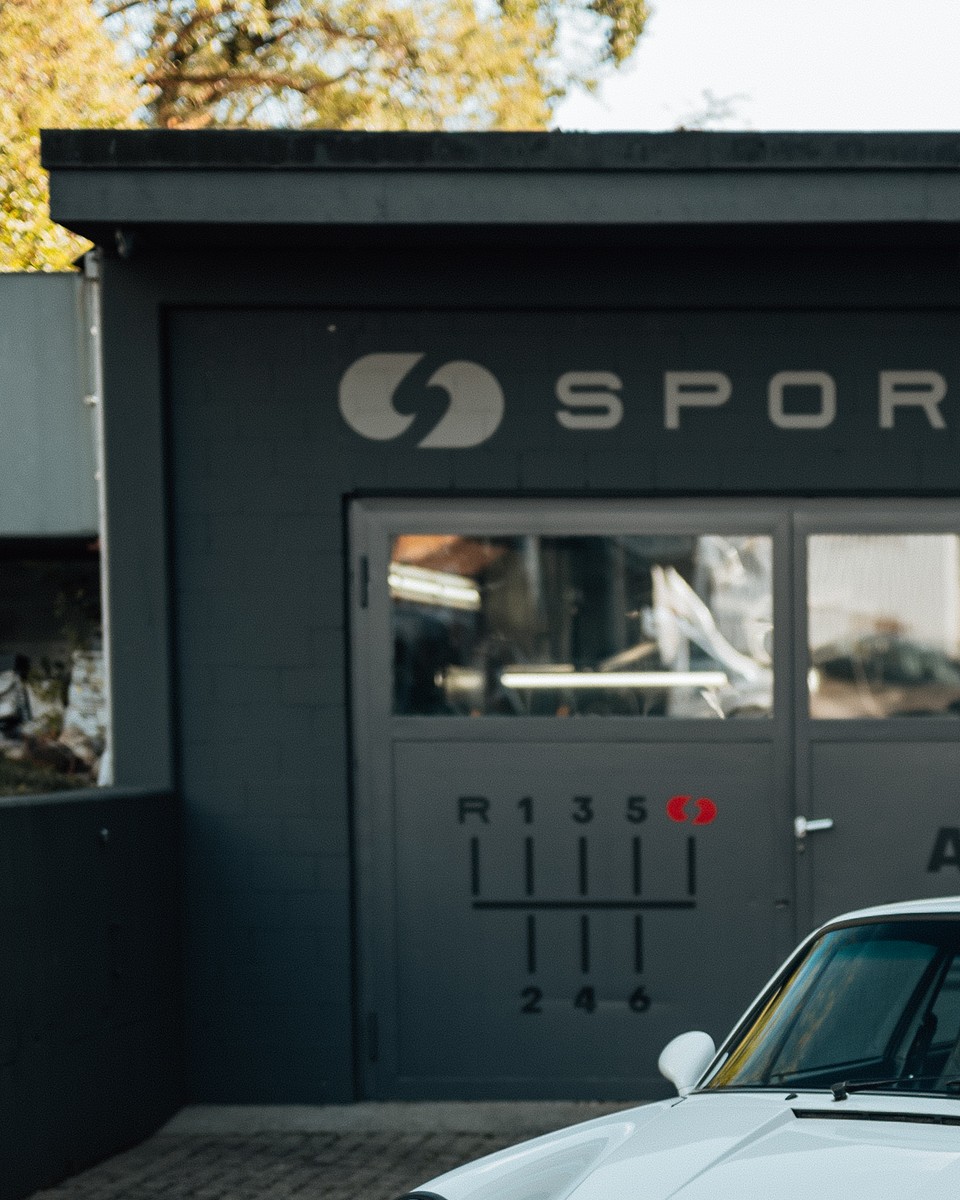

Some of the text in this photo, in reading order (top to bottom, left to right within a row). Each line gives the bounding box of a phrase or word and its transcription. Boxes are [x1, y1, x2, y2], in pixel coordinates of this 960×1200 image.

[457, 796, 648, 825] R 1 3 5
[520, 985, 652, 1014] 2 4 6
